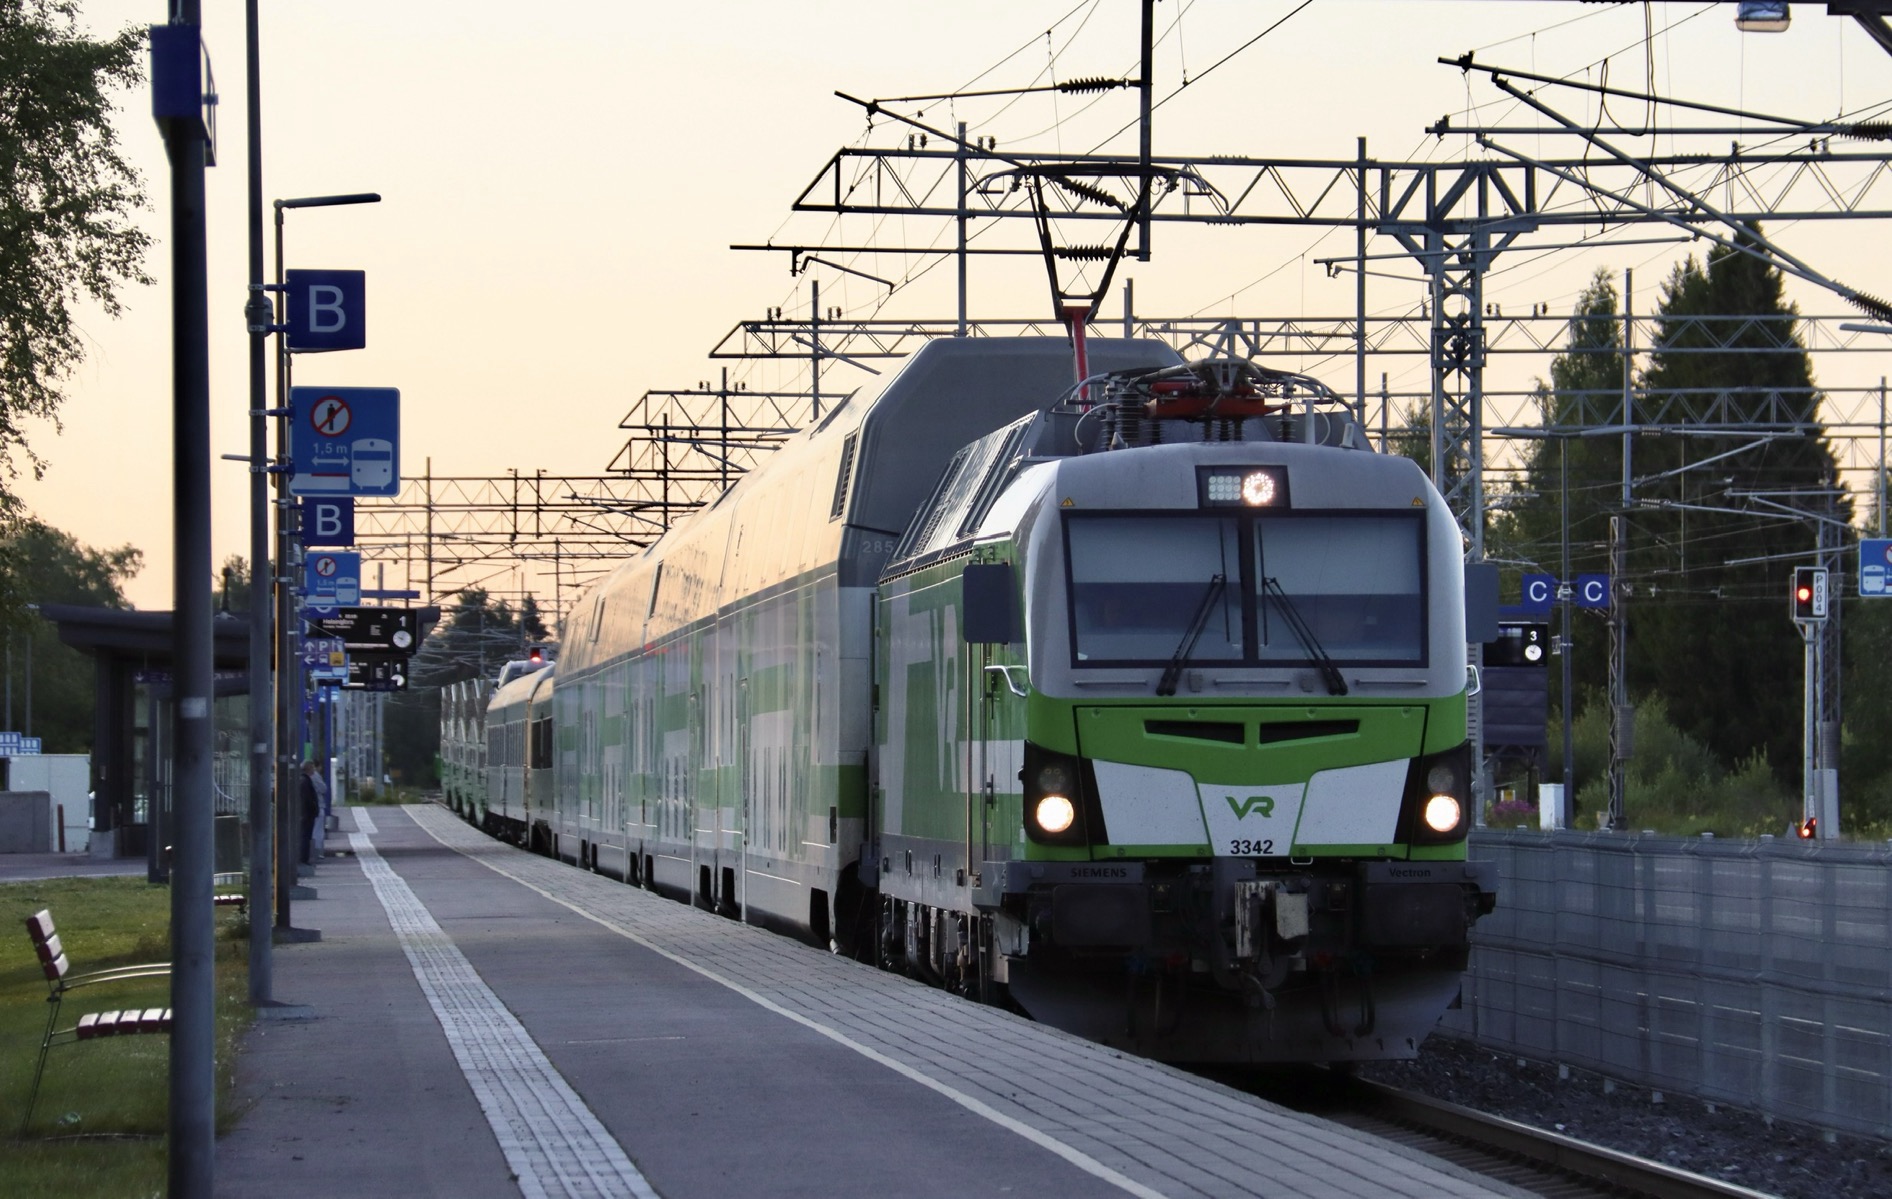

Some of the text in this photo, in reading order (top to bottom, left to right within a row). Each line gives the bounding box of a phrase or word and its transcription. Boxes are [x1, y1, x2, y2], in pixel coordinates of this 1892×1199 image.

[308, 284, 346, 333] B
[312, 443, 348, 455] 1,5 m
[316, 504, 342, 536] B
[1529, 581, 1547, 602] C
[1584, 581, 1603, 602] C
[1815, 575, 1824, 612] P004
[399, 615, 407, 627] 1
[1529, 630, 1538, 641] 3
[1225, 796, 1275, 821] VR
[1230, 840, 1274, 855] 3342
[1070, 867, 1127, 878] SIEMENS
[1389, 867, 1432, 878] Vectron
